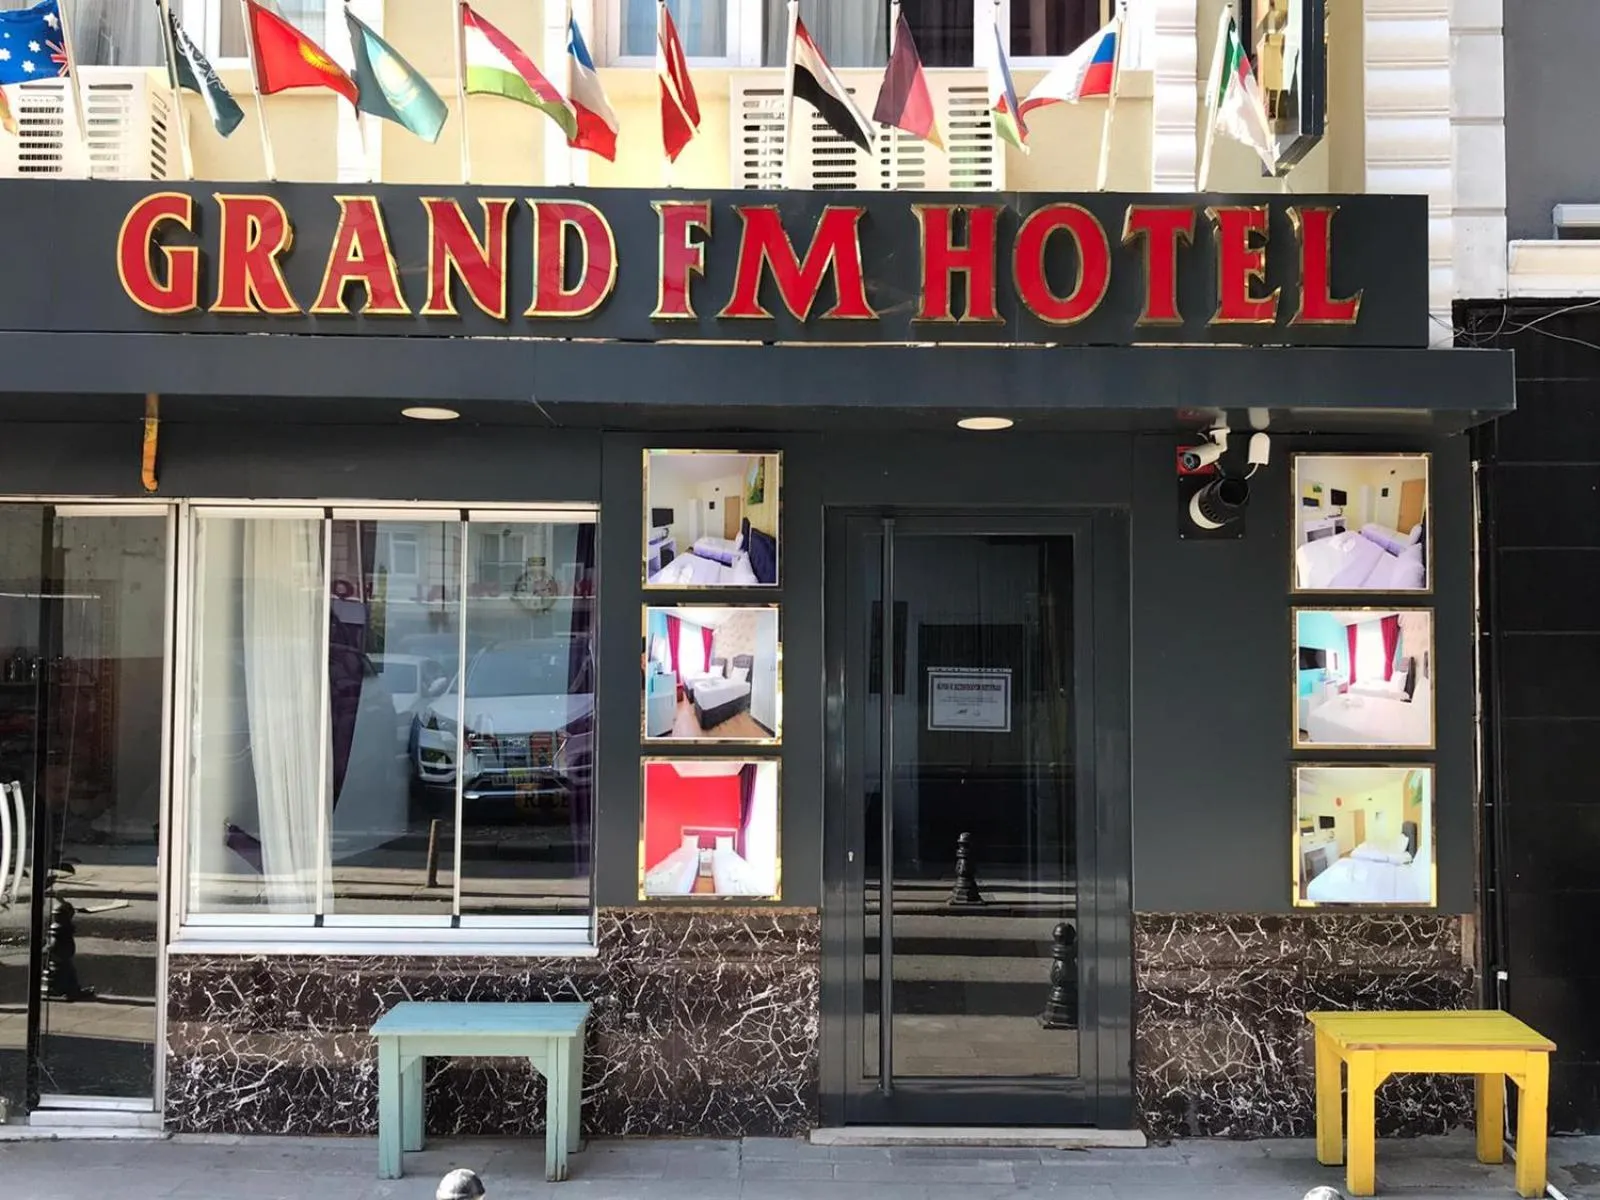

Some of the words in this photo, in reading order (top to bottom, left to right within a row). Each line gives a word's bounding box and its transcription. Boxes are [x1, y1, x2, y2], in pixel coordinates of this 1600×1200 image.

[117, 191, 618, 320] GRAND
[649, 199, 881, 322] FM
[909, 202, 1363, 326] HOTEL
